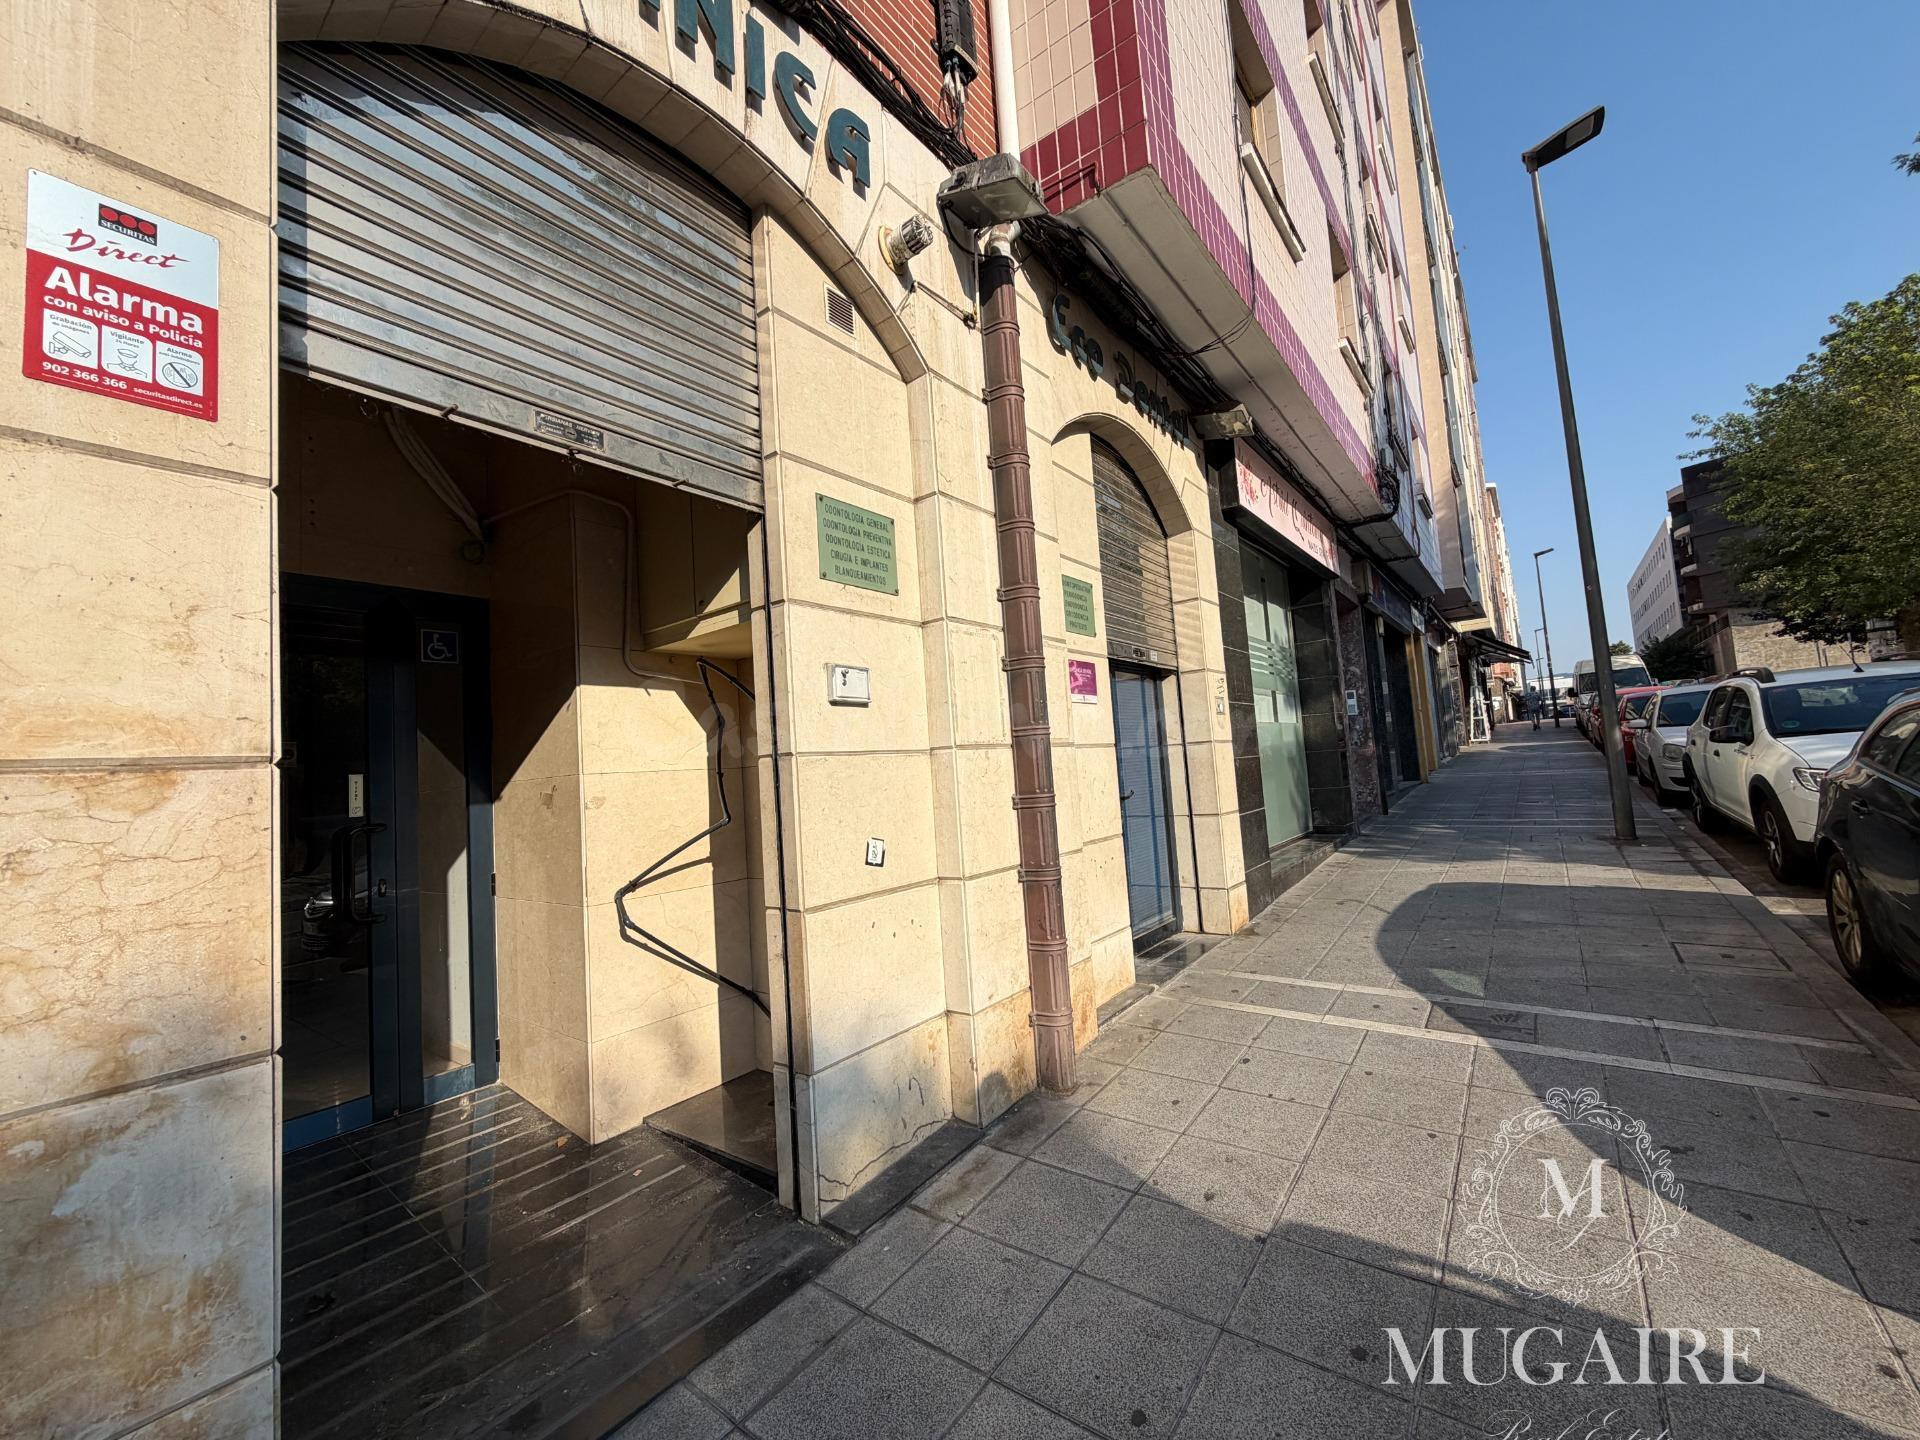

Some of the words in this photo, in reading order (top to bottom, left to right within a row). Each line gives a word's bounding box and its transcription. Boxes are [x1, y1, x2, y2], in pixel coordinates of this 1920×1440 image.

[648, 0, 871, 188] NICA
[101, 220, 155, 244] SECURITAS
[63, 228, 190, 268] Direct
[44, 266, 203, 335] Alarma
[44, 295, 78, 312] con
[83, 305, 129, 327] aviso
[134, 320, 144, 331] a
[149, 324, 203, 348] Policía
[49, 314, 93, 331] Grabación
[110, 331, 145, 345] Vigilante
[167, 347, 193, 359] Alarma
[42, 362, 70, 376] 902
[73, 369, 99, 382] 366
[102, 376, 128, 390] 366
[133, 386, 203, 409] securitasdirect.es
[866, 517, 889, 533] GENERAL
[861, 557, 889, 573] IMPLANTES
